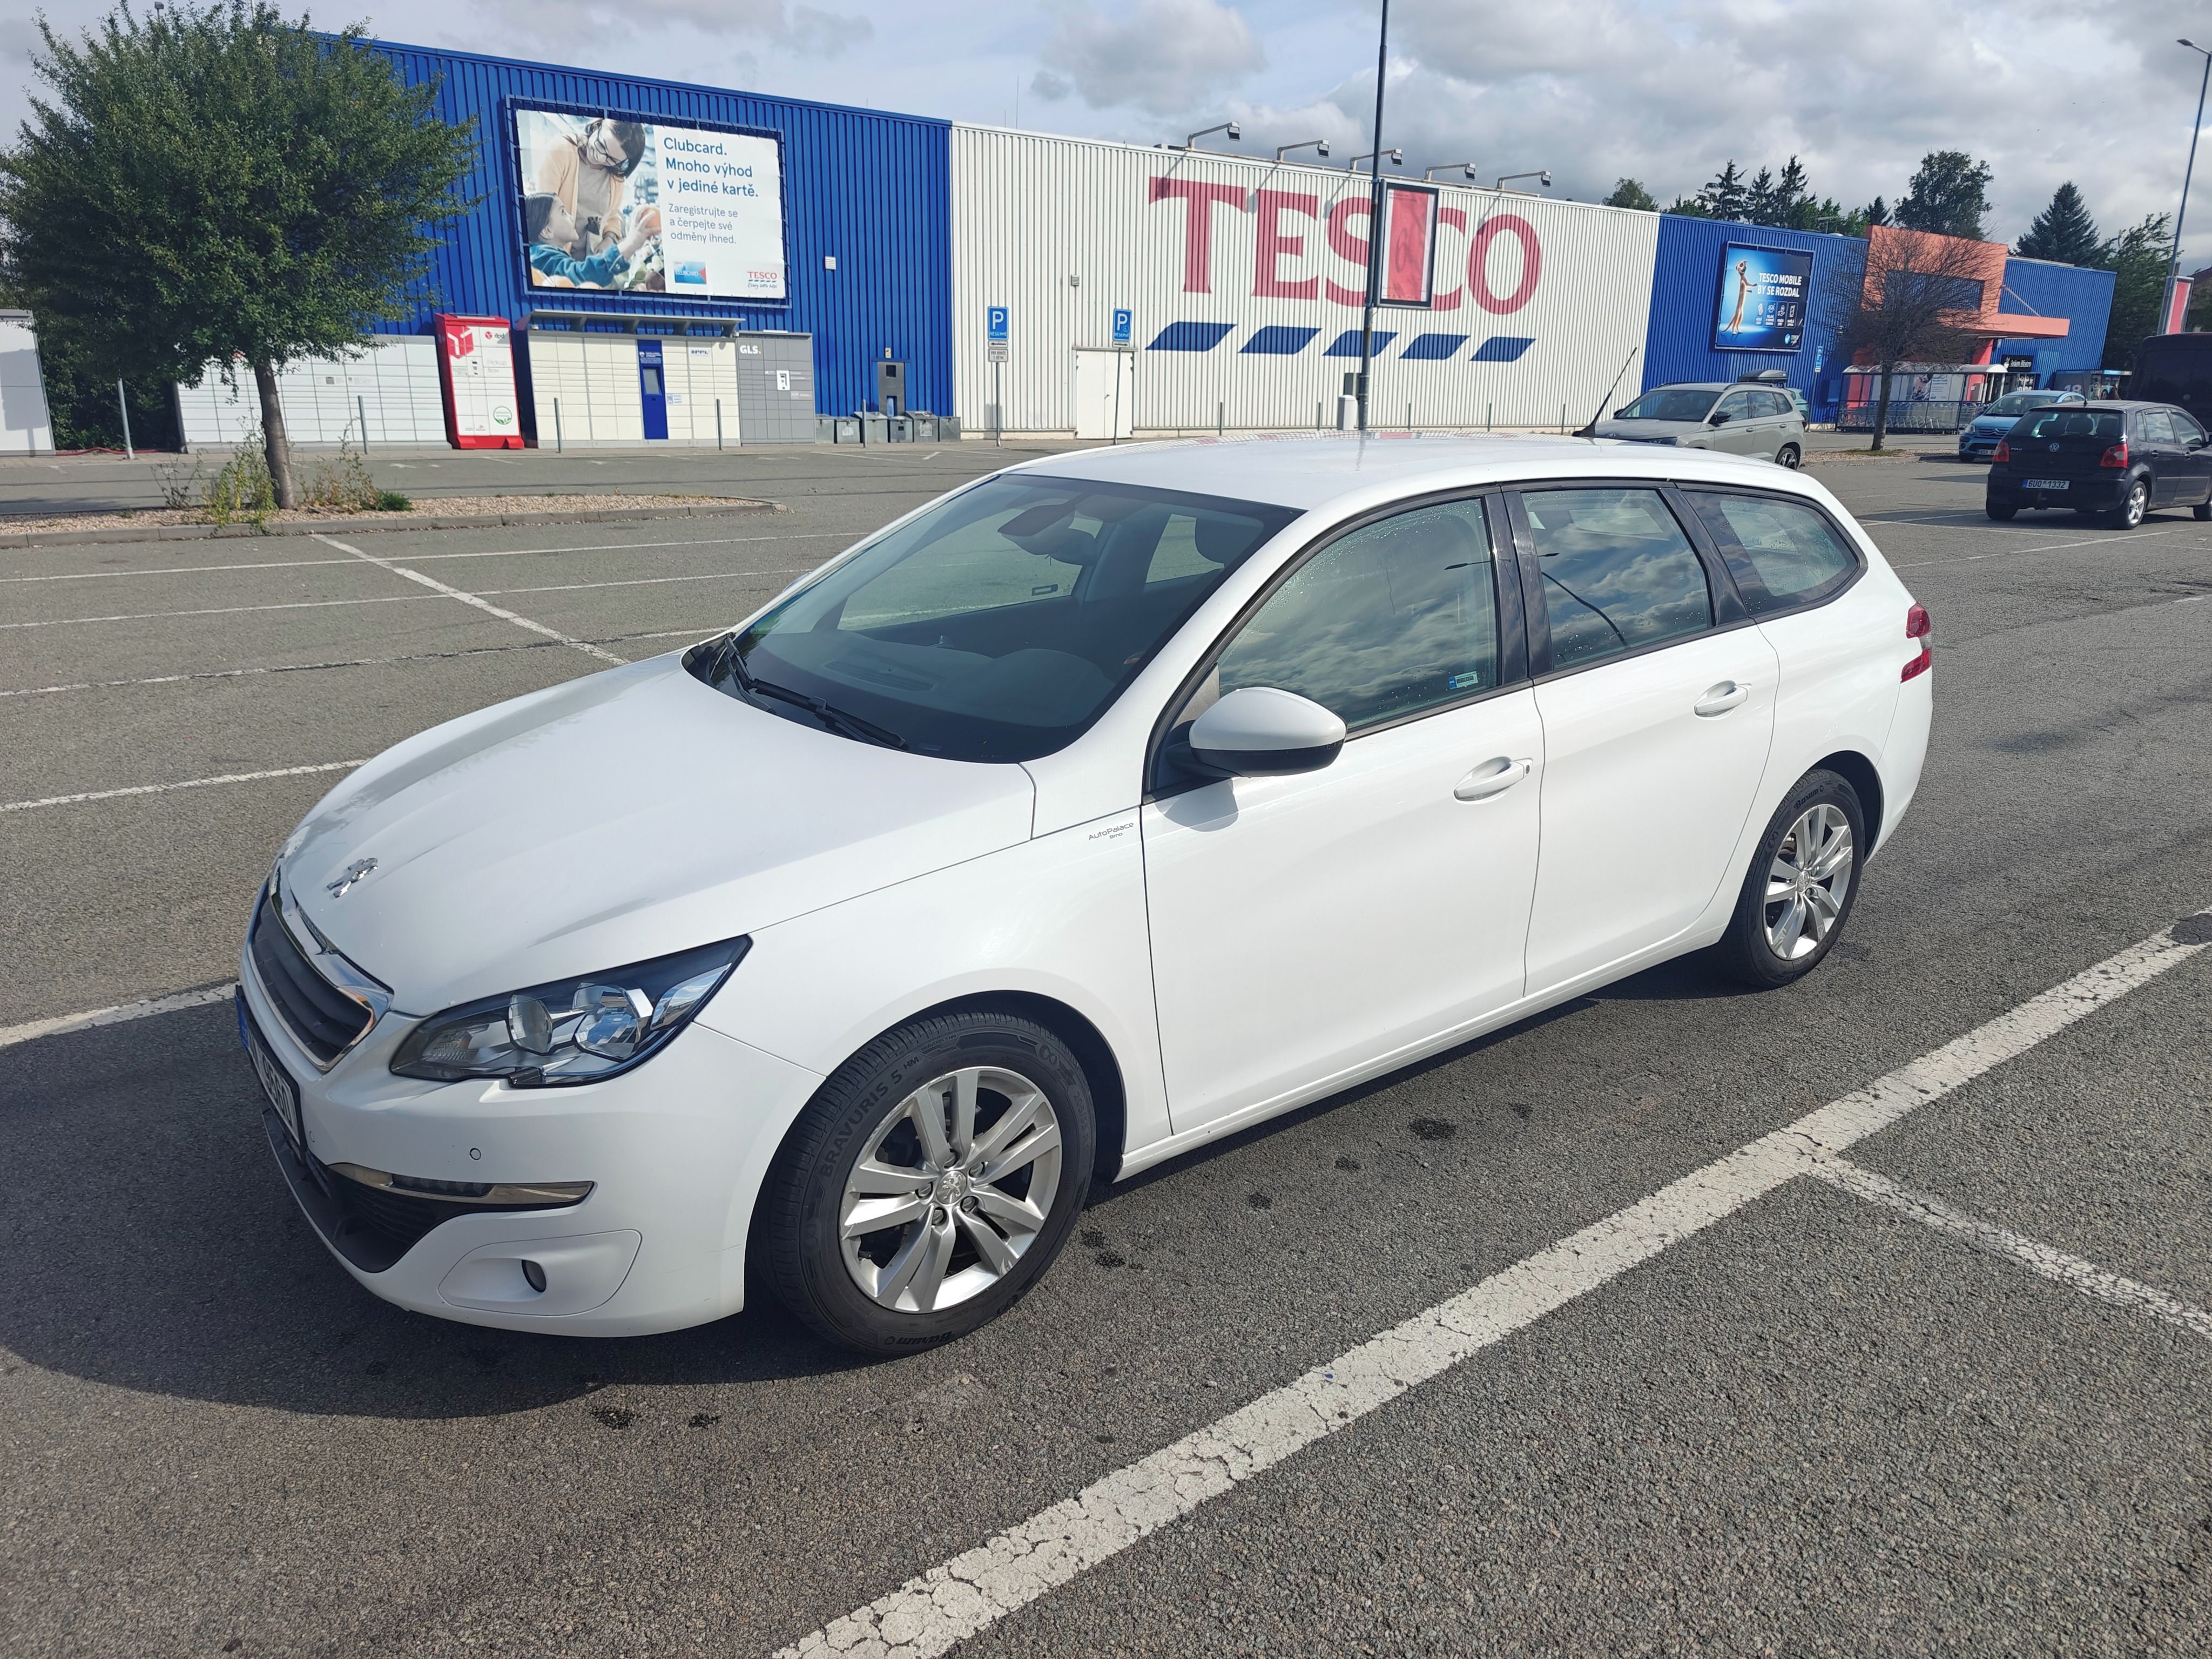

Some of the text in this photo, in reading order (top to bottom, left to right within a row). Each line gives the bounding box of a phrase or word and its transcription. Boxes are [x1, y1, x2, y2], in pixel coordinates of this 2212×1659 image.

[664, 137, 727, 156] Clubcard.
[666, 157, 752, 178] Mnoho výhod
[667, 178, 758, 198] v jediné kartě.
[669, 203, 726, 218] Zaregistrujte
[677, 217, 716, 231] čerpejte
[718, 221, 733, 231] své
[671, 231, 736, 244] odměny ihned.
[747, 272, 777, 280] TESCO
[1759, 273, 1802, 286] TESCO MOBILE
[1757, 285, 1800, 298] BY SE ROZDAL
[992, 311, 1004, 330] P
[1117, 313, 1128, 331] P
[2047, 481, 2066, 489] 1332
[1793, 788, 1819, 809] Barum
[1088, 822, 1134, 840] AutoPalace
[820, 1056, 919, 1177] BRAVURIS 5 HM
[896, 1331, 953, 1345] Barum
